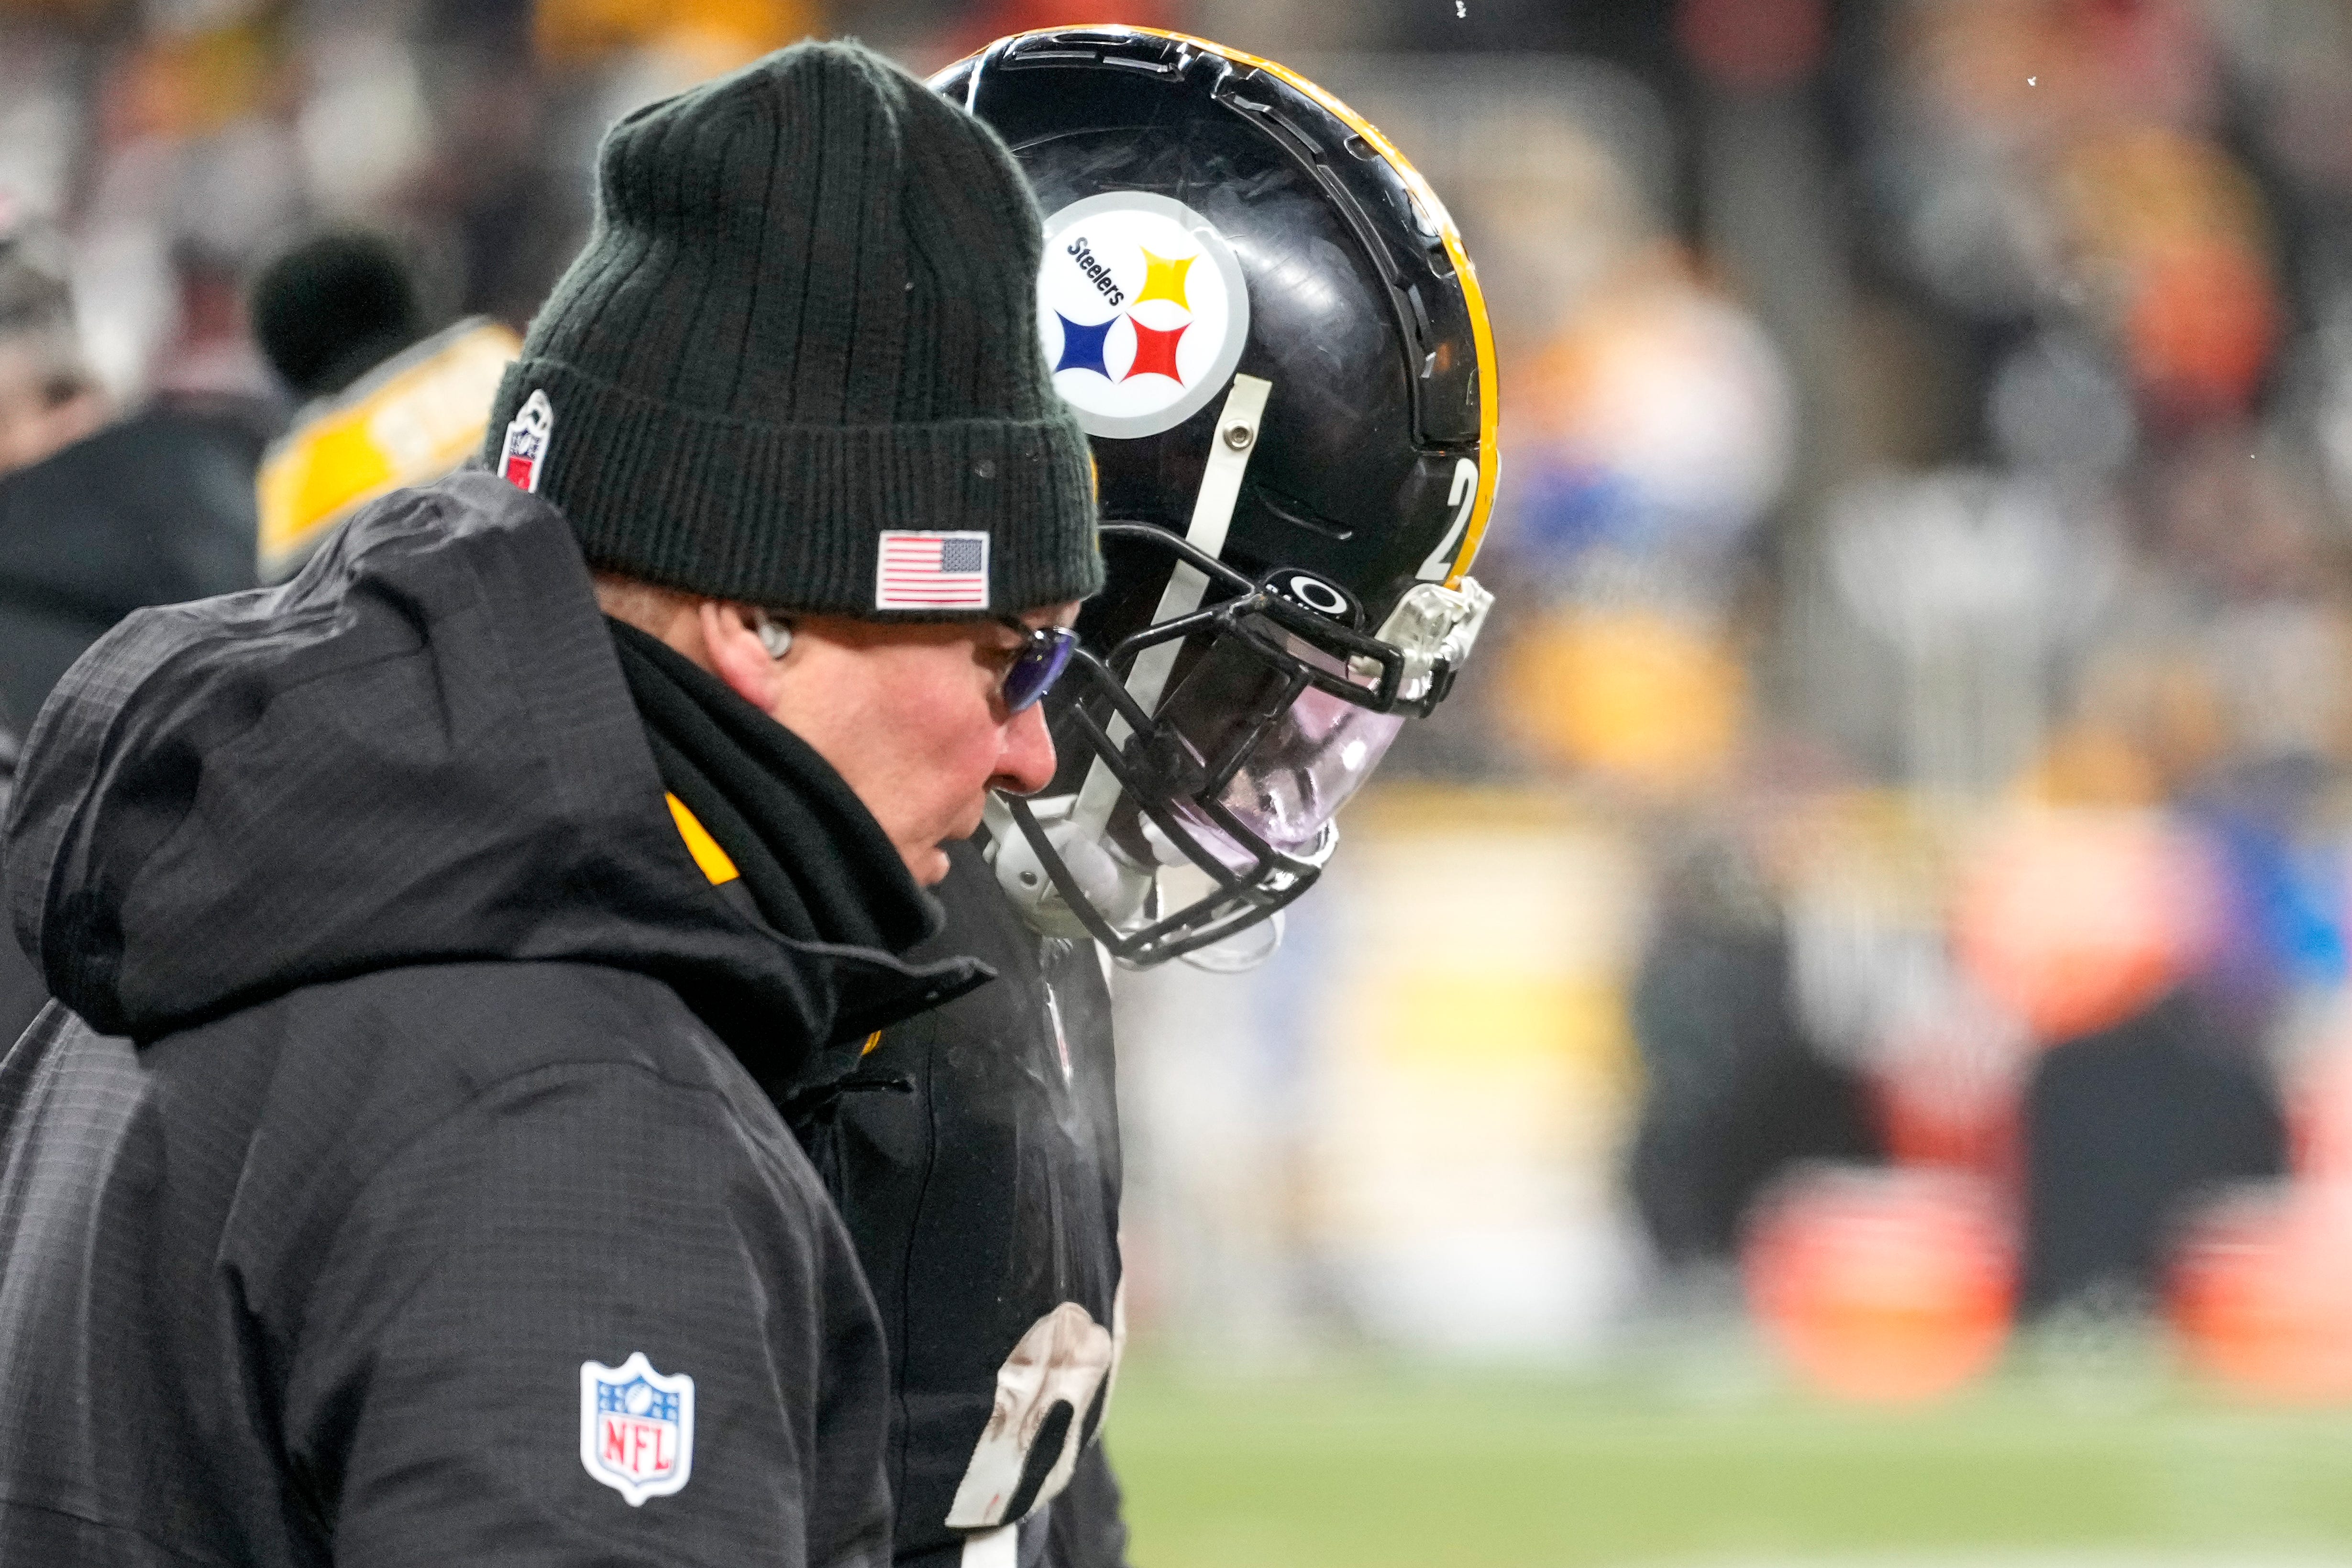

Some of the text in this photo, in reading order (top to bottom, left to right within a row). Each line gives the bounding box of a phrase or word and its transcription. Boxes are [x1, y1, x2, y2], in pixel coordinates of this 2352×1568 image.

[1067, 237, 1125, 307] Steelers
[1415, 458, 1478, 581] 2
[604, 1420, 670, 1473] NFL
